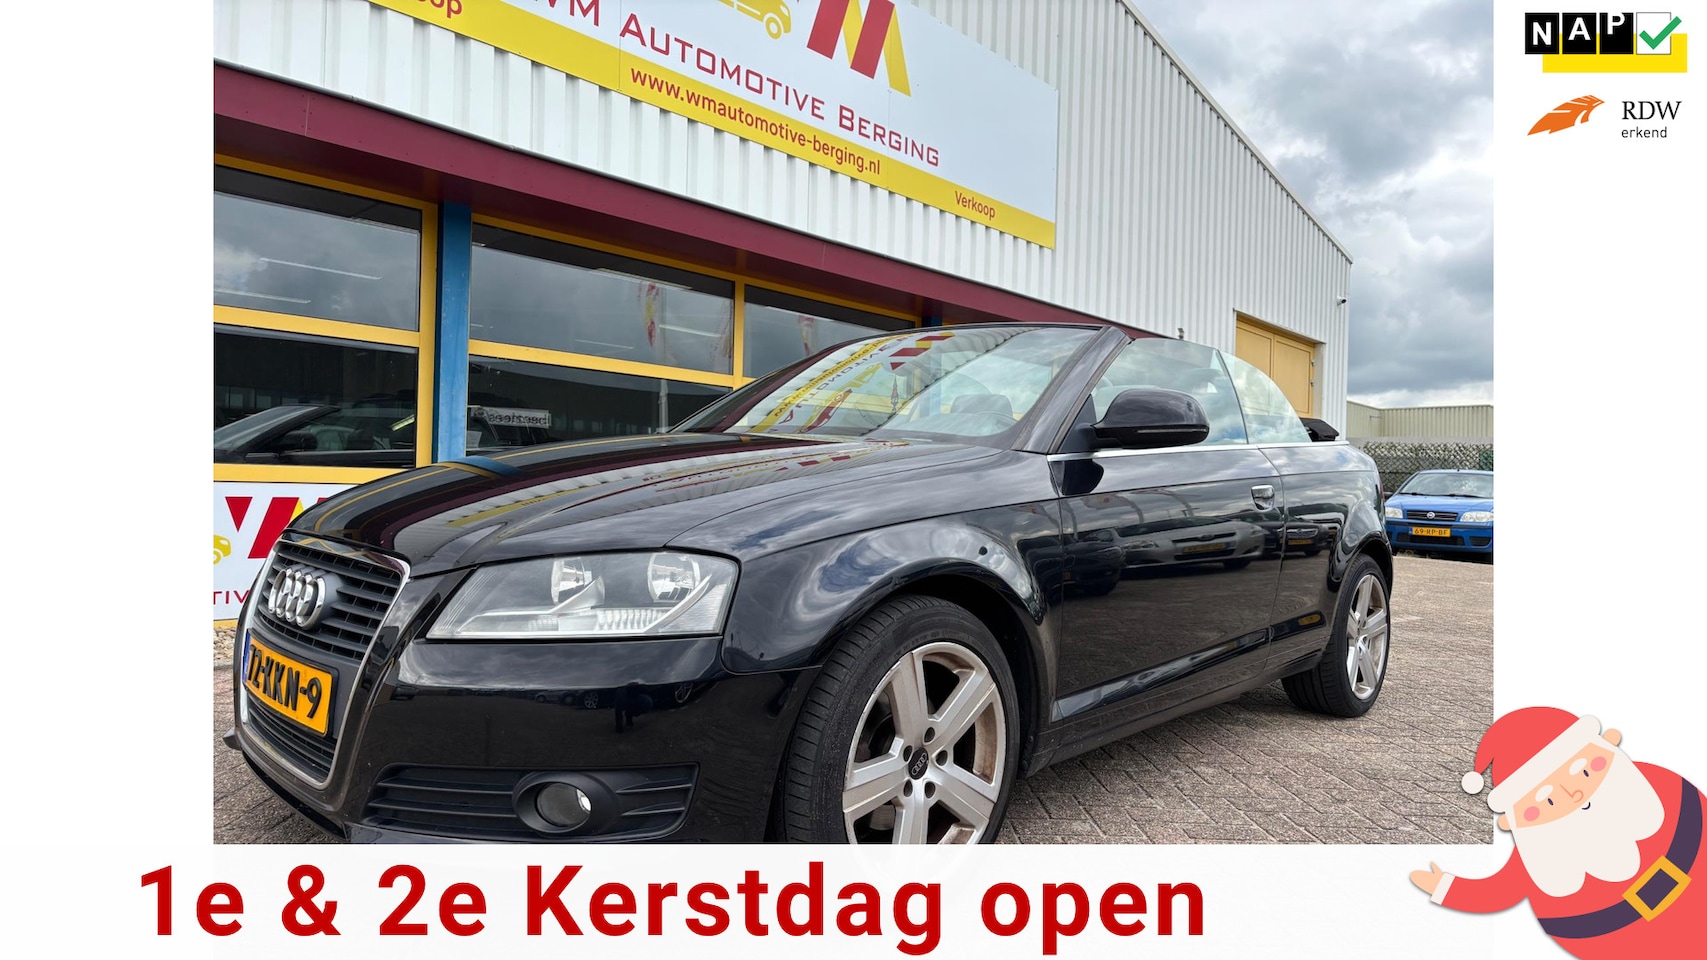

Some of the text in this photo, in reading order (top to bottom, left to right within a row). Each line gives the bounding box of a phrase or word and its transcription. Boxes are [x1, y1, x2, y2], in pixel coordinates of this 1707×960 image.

[619, 12, 825, 121] AUTOMOTIVE
[838, 104, 939, 167] BERGING
[630, 67, 881, 175] www.wmautomotive-berging.nl
[954, 190, 996, 221] Verkoop
[1414, 527, 1449, 536] 69-RP-BF
[247, 643, 323, 720] 72-KKN-9
